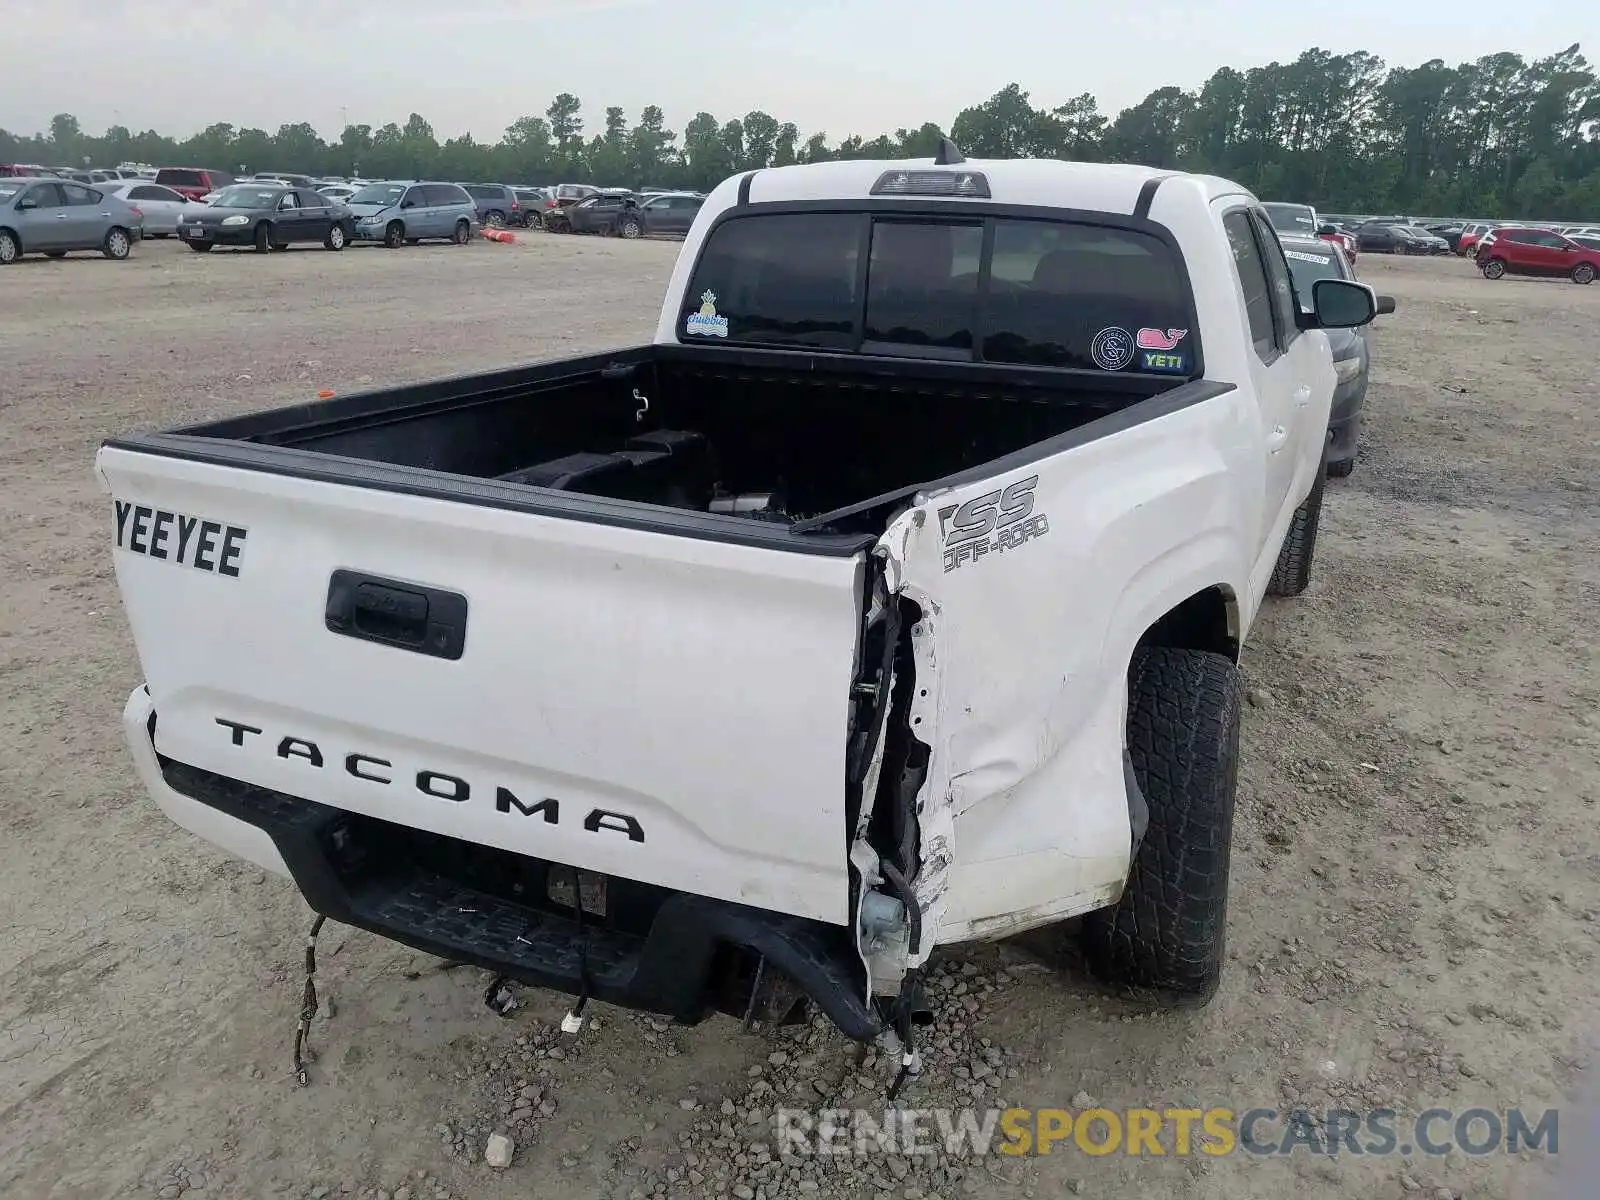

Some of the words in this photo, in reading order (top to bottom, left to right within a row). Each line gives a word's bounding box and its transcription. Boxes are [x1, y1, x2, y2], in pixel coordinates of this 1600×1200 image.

[1146, 354, 1182, 368] YETI
[115, 500, 247, 577] YEEYEE
[943, 513, 1049, 574] OFF-ROAD
[215, 718, 645, 843] TACOMA
